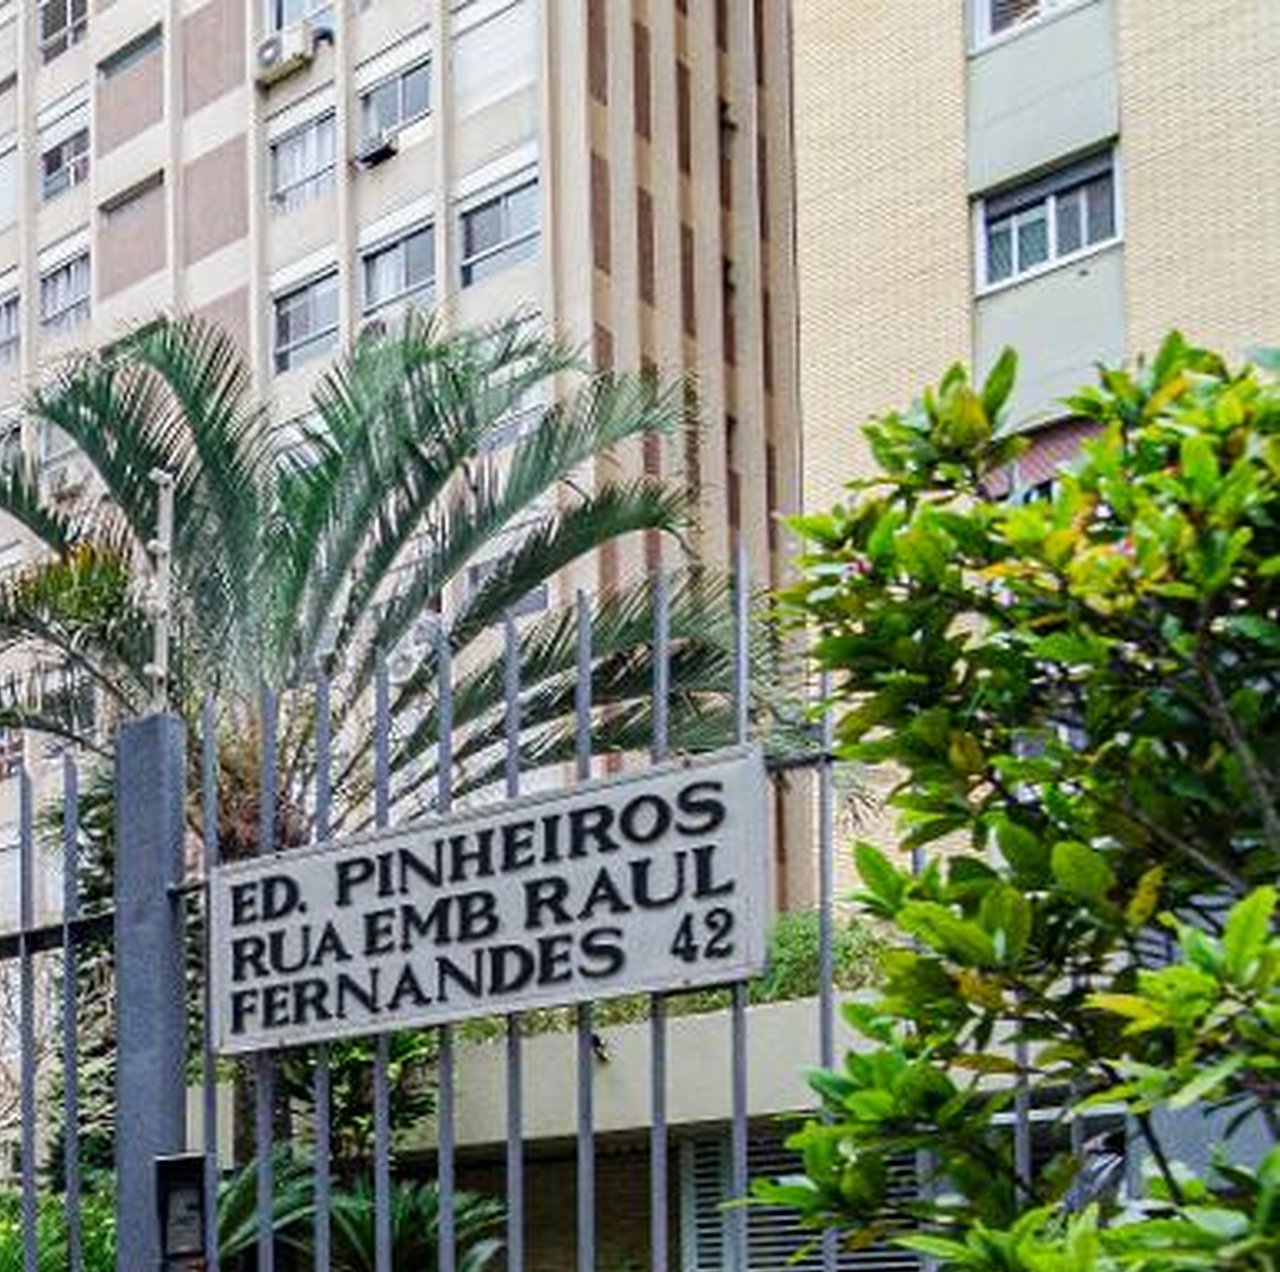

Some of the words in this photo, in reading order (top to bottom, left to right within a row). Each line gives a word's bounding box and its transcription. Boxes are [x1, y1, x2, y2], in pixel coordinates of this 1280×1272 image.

[231, 874, 307, 927] ED.
[335, 781, 726, 907] PINHEIROS
[231, 919, 353, 983] RUA
[362, 890, 500, 956] EMB
[524, 845, 736, 931] RAUL
[230, 928, 627, 1035] FERNANDES
[670, 907, 735, 964] 42
